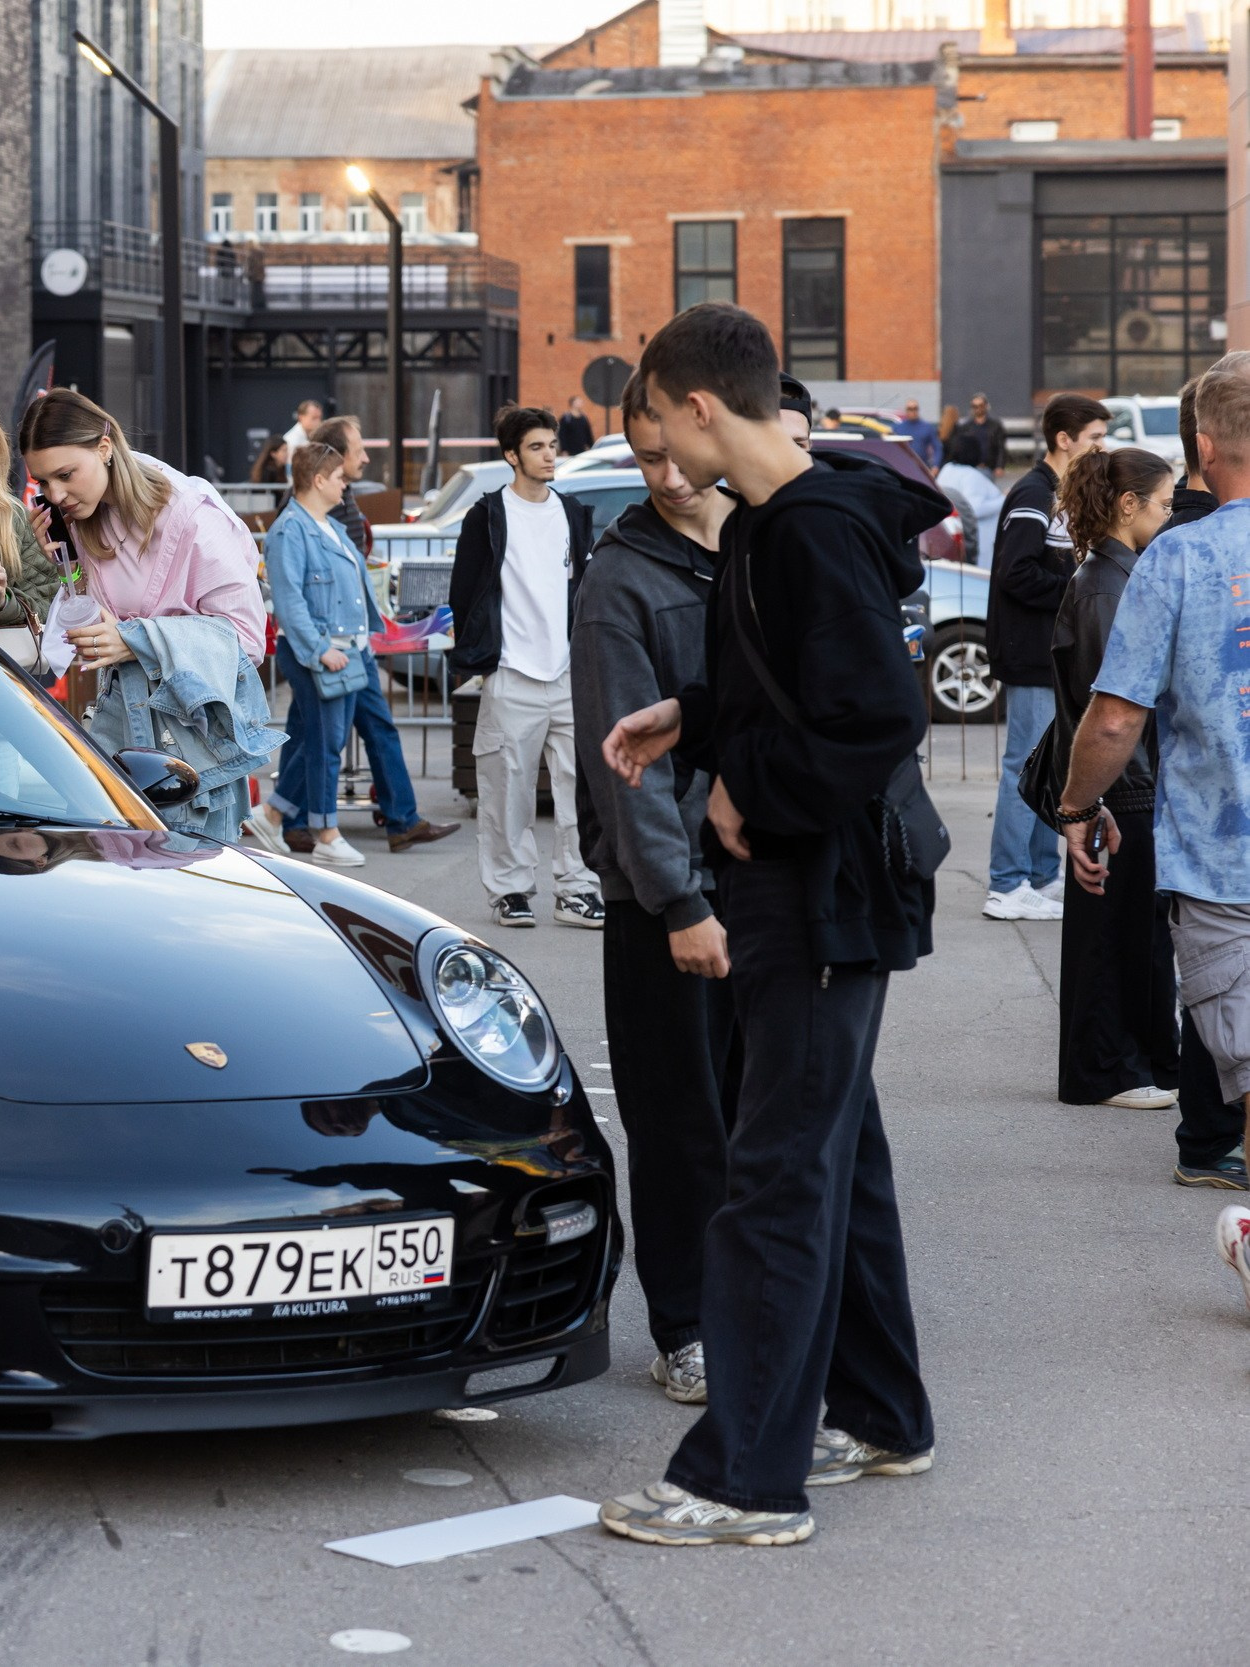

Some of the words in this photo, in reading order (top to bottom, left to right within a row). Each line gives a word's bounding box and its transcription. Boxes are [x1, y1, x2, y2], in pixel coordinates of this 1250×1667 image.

[170, 1240, 366, 1299] Т879ЕК
[377, 1226, 442, 1271] 550
[388, 1270, 422, 1287] RUS
[291, 1299, 349, 1316] KULTURA
